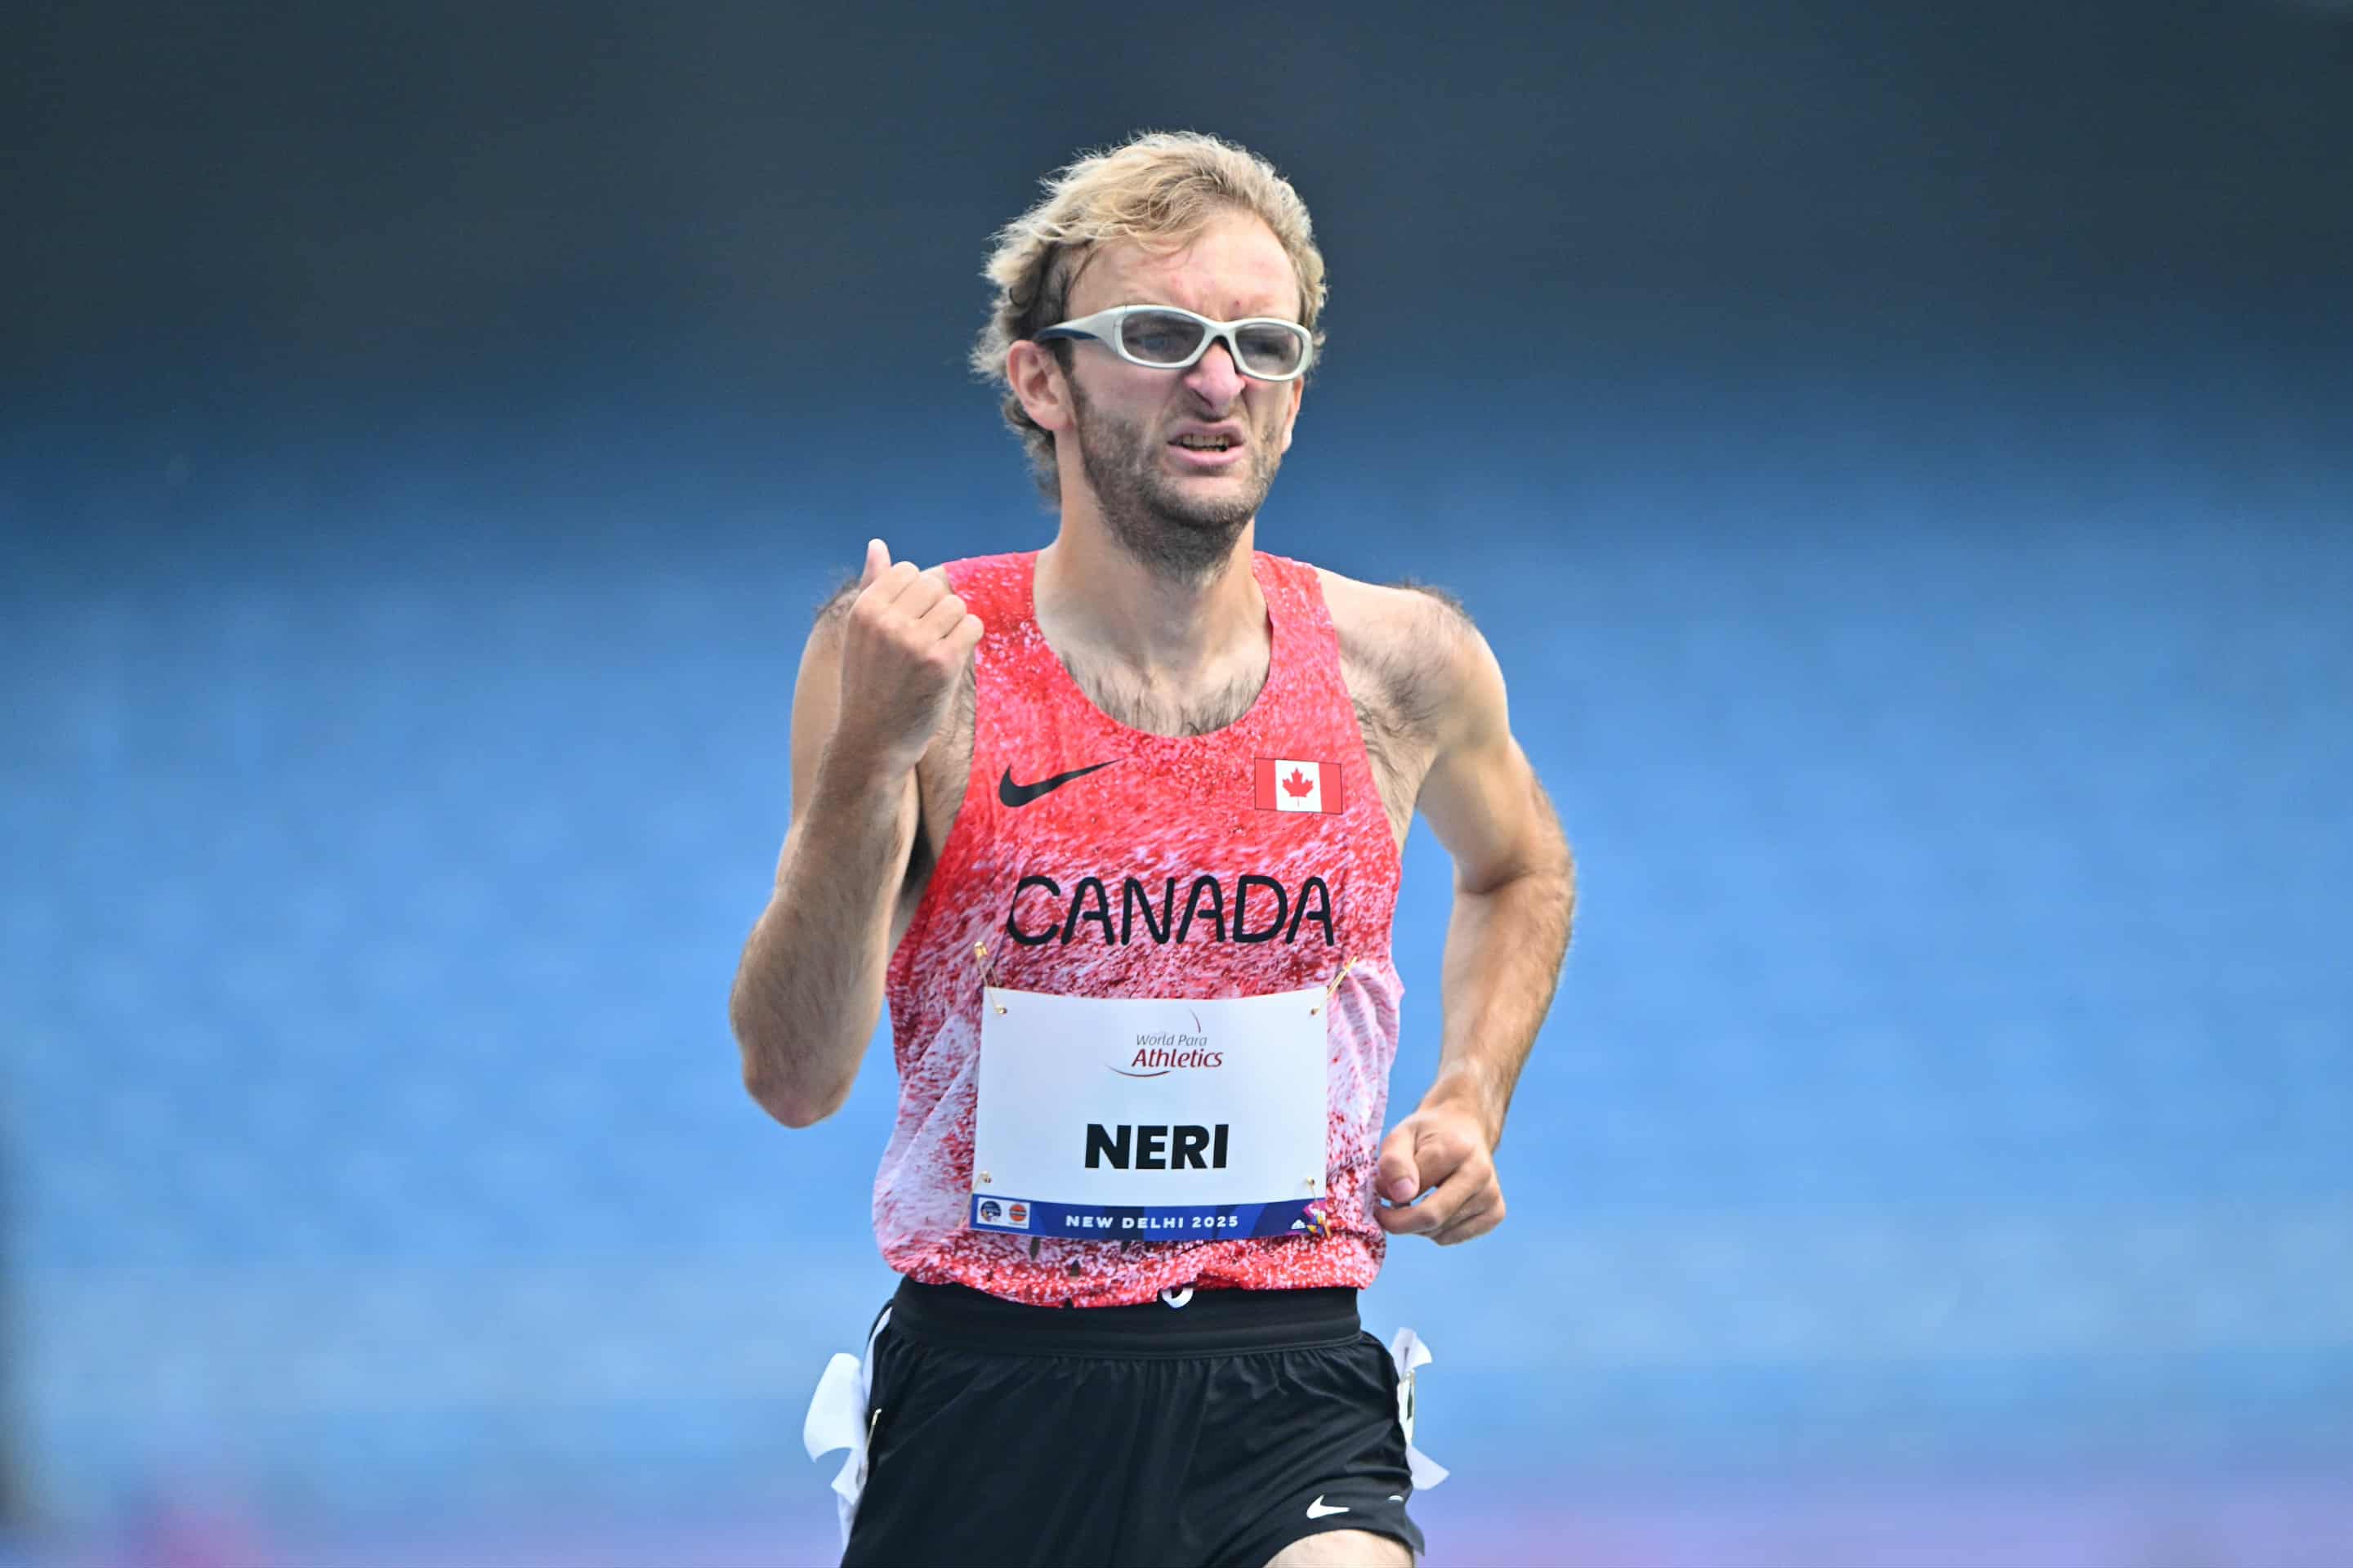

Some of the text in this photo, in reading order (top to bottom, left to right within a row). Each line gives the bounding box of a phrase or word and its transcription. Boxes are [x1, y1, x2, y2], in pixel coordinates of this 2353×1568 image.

[1006, 874, 1334, 946] CANADA
[1136, 1034, 1208, 1046] World Para
[1131, 1048, 1224, 1068] Athletics
[1085, 1124, 1230, 1170] NERI
[1065, 1215, 1239, 1229] NEW DELHI 2025
